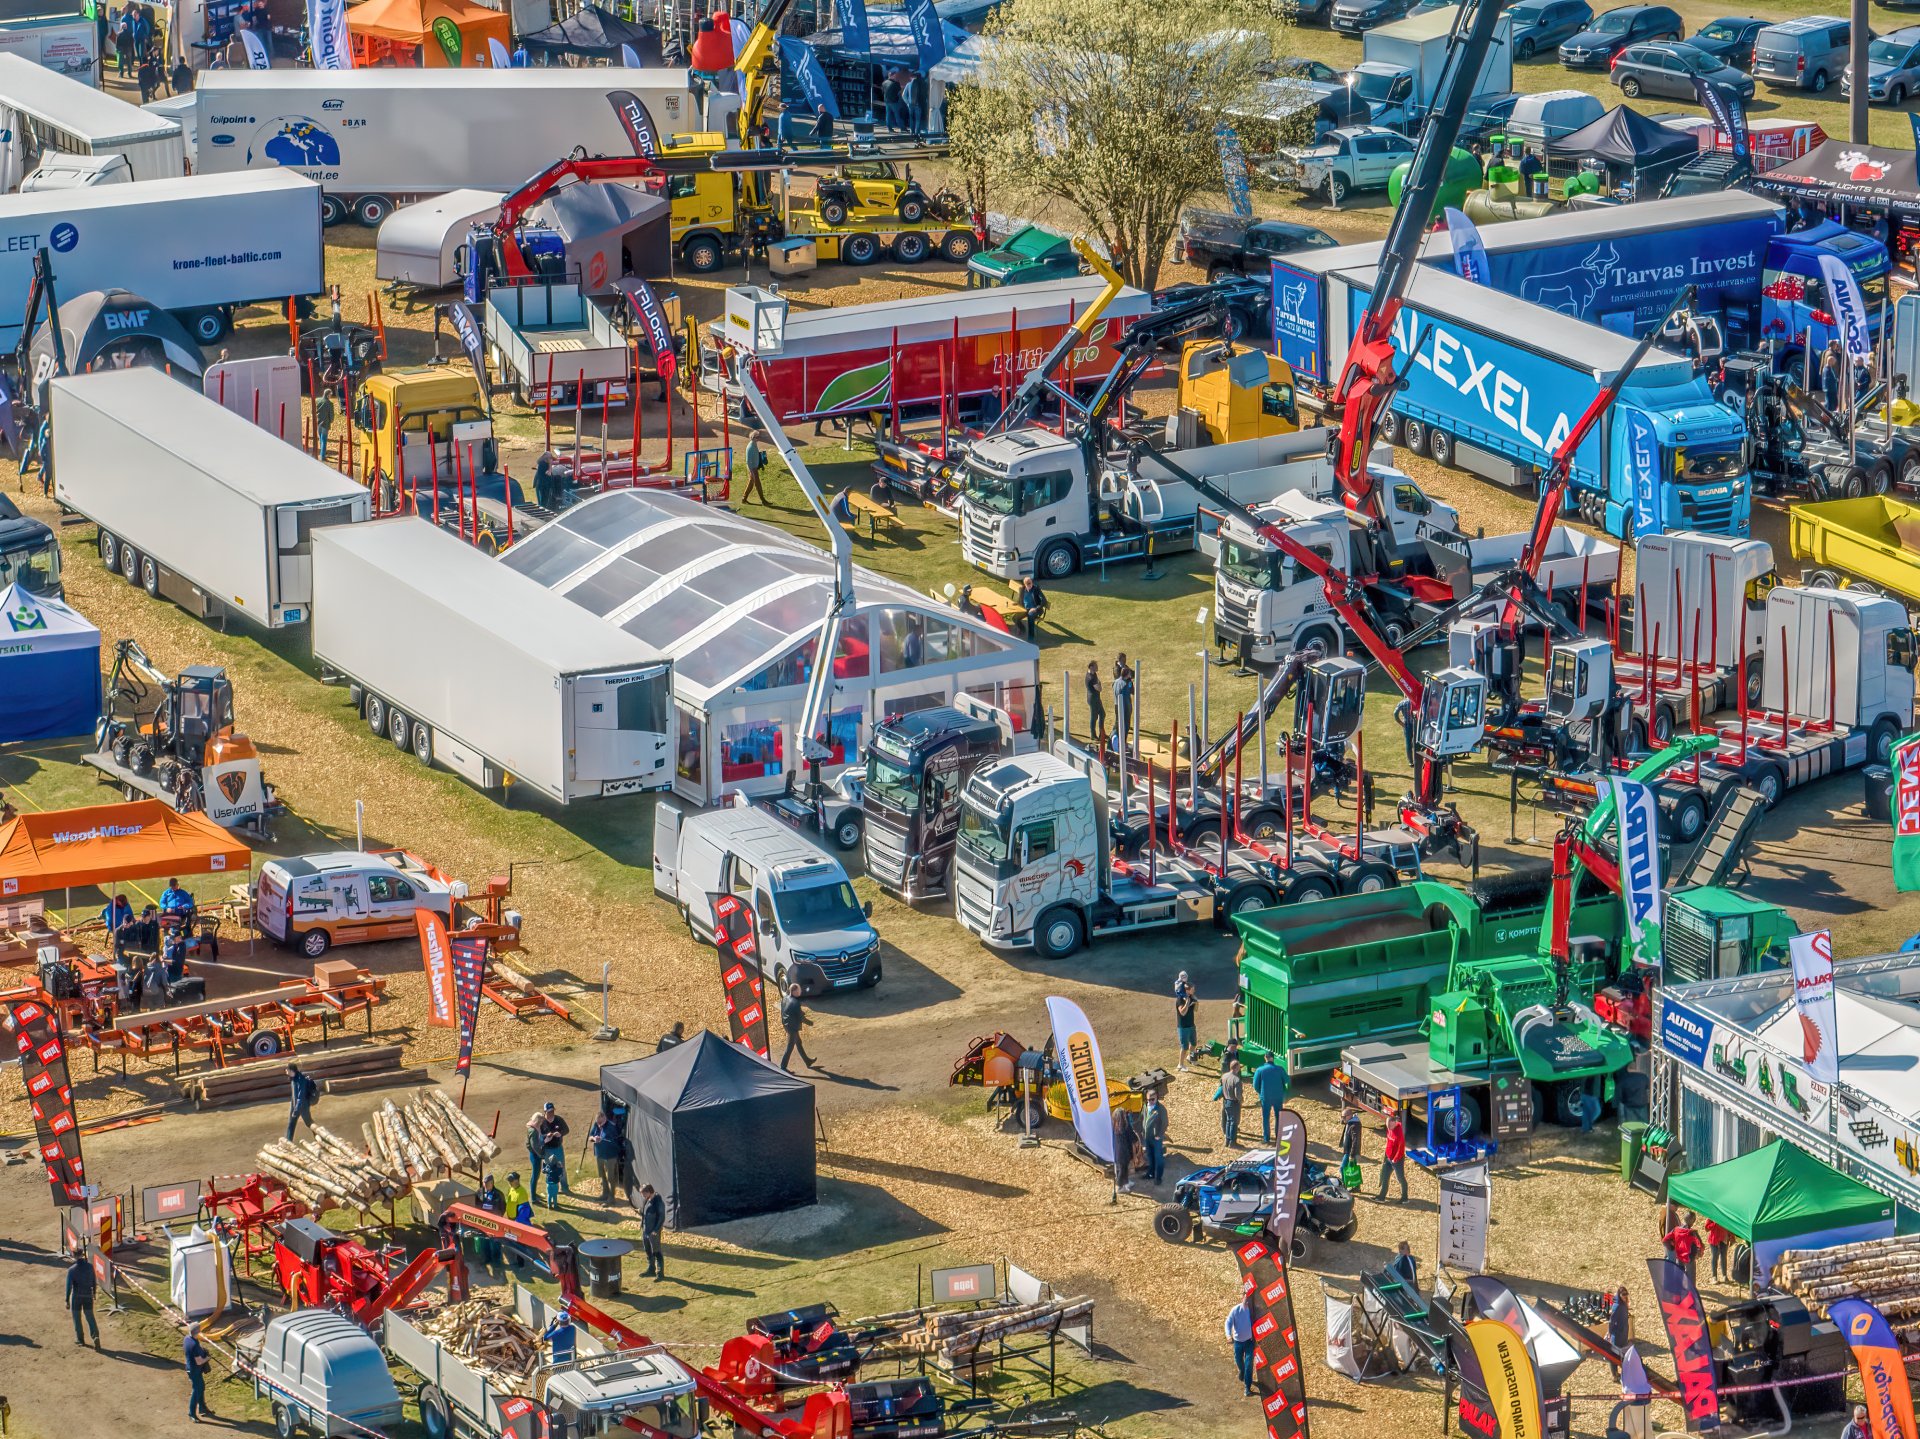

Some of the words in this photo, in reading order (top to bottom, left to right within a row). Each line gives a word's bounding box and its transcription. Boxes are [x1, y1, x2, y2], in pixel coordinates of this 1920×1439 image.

[210, 116, 248, 126] foilpoint
[303, 171, 339, 184] oint.ee
[1818, 179, 1837, 188] THE
[1838, 180, 1872, 194] LIGHTS
[1831, 192, 1866, 204] AUTOLINE
[172, 251, 282, 269] krone-fleet-baltic.com
[1610, 264, 1684, 287] Tarvas
[1689, 250, 1757, 275] Invest
[103, 309, 151, 330] BMF
[1393, 308, 1572, 457] ALEXELA
[1697, 486, 1728, 497] SCANIA
[604, 678, 631, 686] THERMO
[632, 674, 646, 682] KING
[213, 803, 257, 819] Usewood
[52, 825, 143, 844] Wood-Mizer
[1507, 925, 1542, 939] KOMPTEC
[1666, 1011, 1704, 1040] AUTRA
[463, 1213, 499, 1231] PALFINGER
[1460, 1397, 1498, 1437] PALAX
